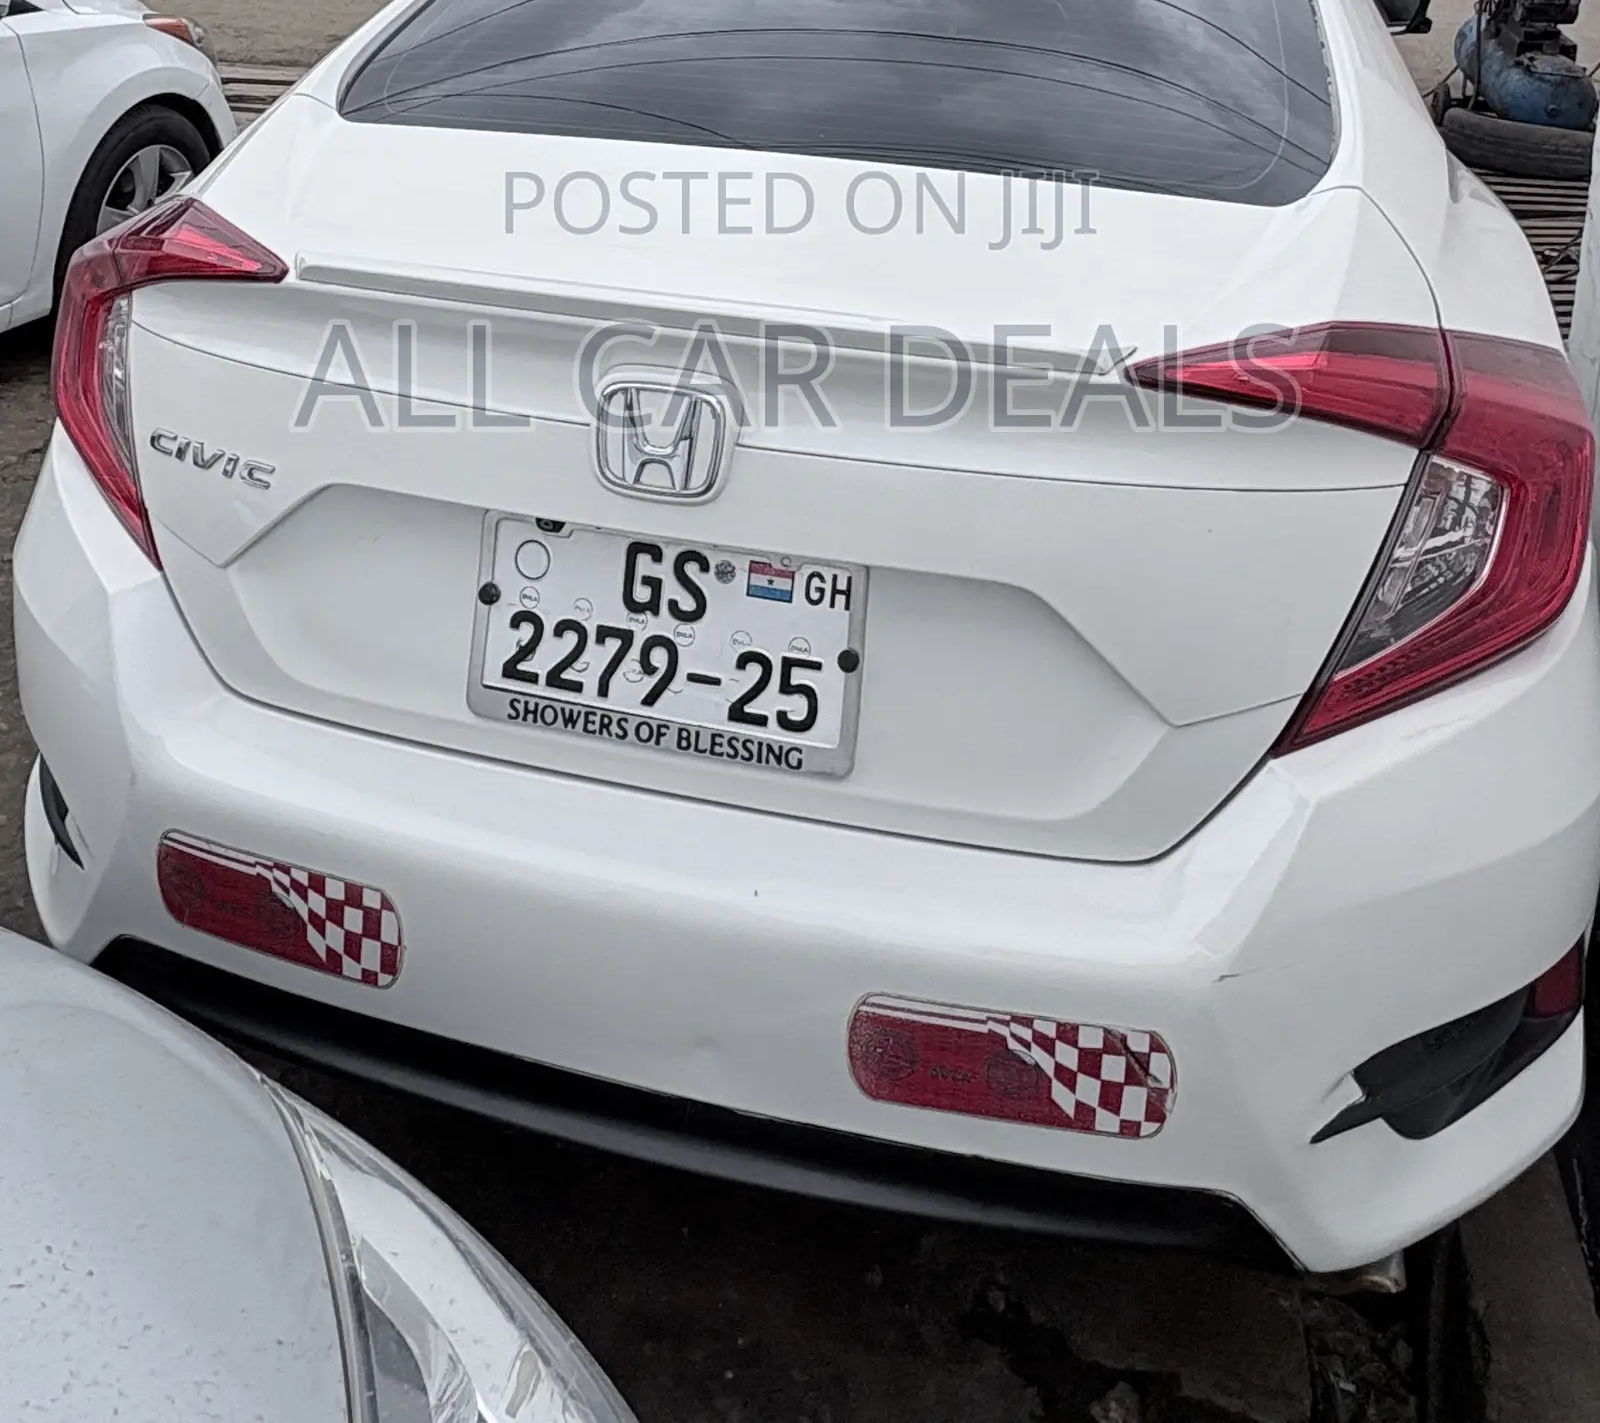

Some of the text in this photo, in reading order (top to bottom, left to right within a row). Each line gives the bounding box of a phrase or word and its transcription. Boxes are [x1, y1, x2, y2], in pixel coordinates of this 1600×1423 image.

[149, 427, 277, 490] CIVIC
[622, 541, 711, 623] GS
[804, 570, 852, 612] GH
[502, 610, 822, 733] 2279-25
[507, 698, 804, 771] SHOWERS OF BLESSING
